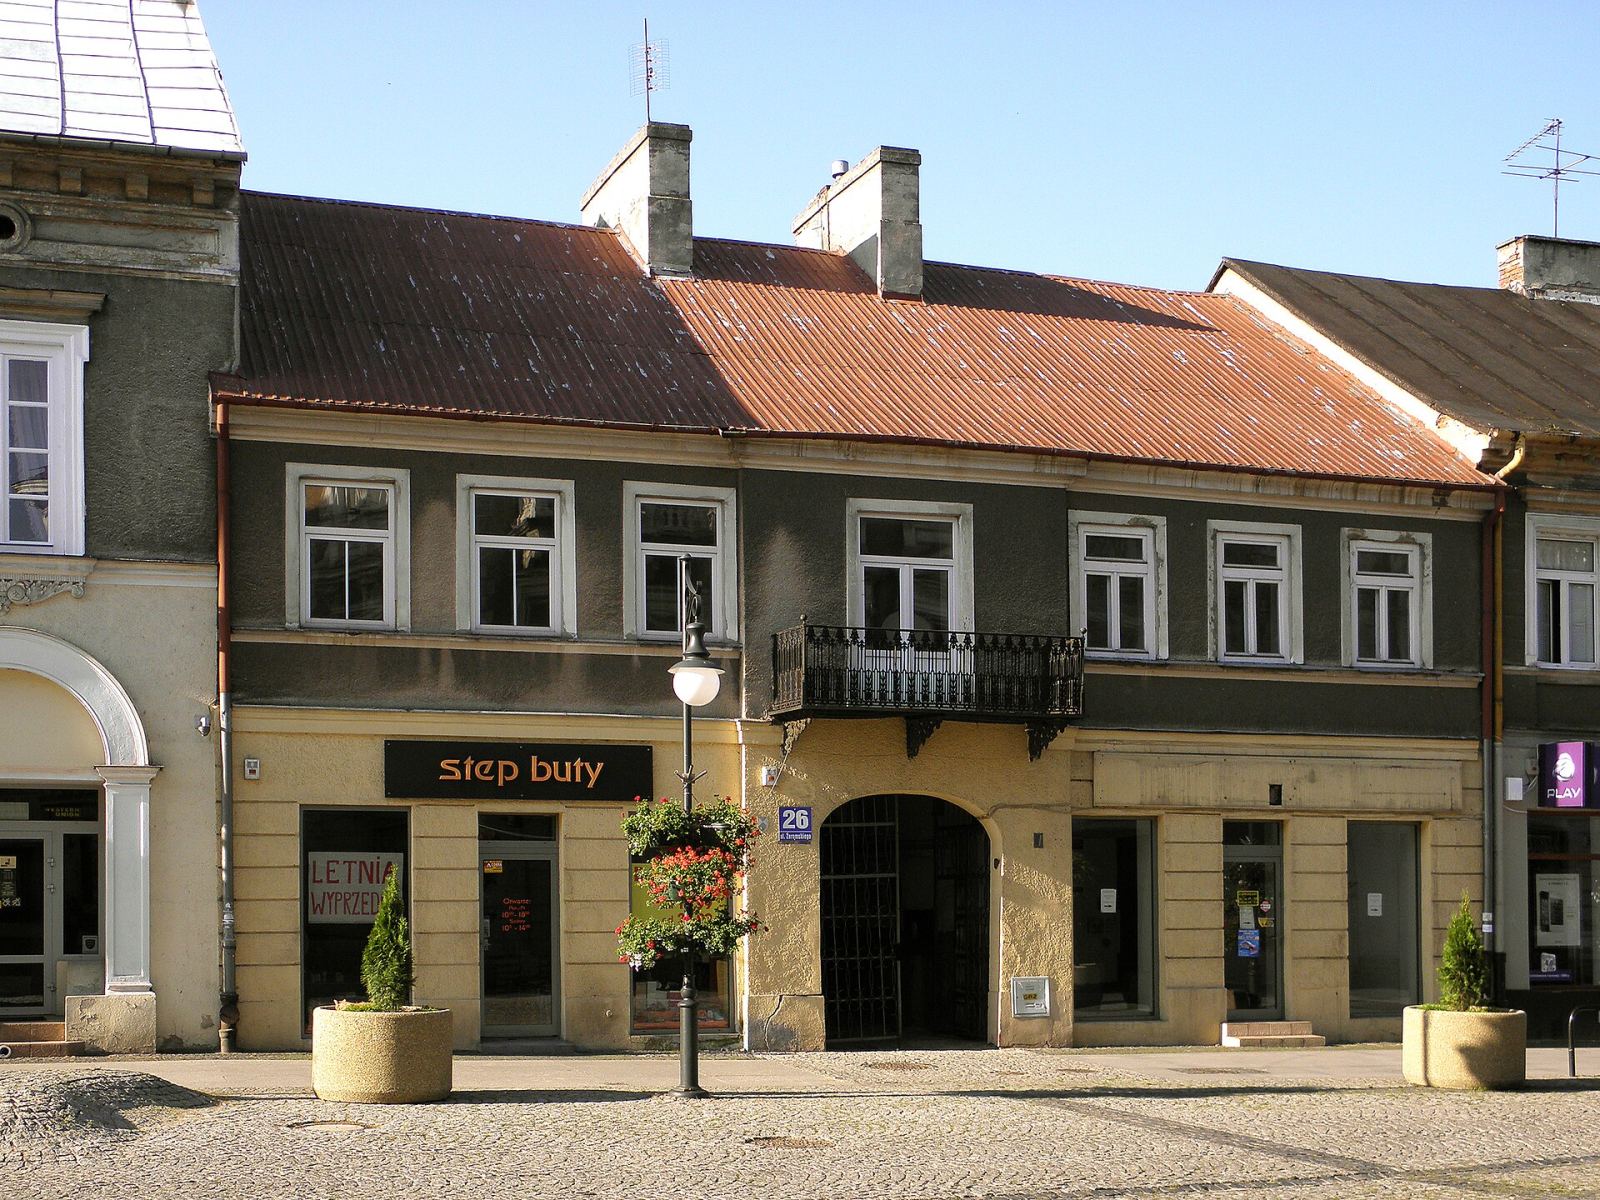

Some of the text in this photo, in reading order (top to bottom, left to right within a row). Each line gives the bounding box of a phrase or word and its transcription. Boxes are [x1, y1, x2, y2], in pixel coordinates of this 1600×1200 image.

[439, 755, 604, 789] step buty
[1547, 788, 1581, 799] PLAY
[783, 809, 808, 829] 26
[311, 892, 384, 915] WYPRZED
